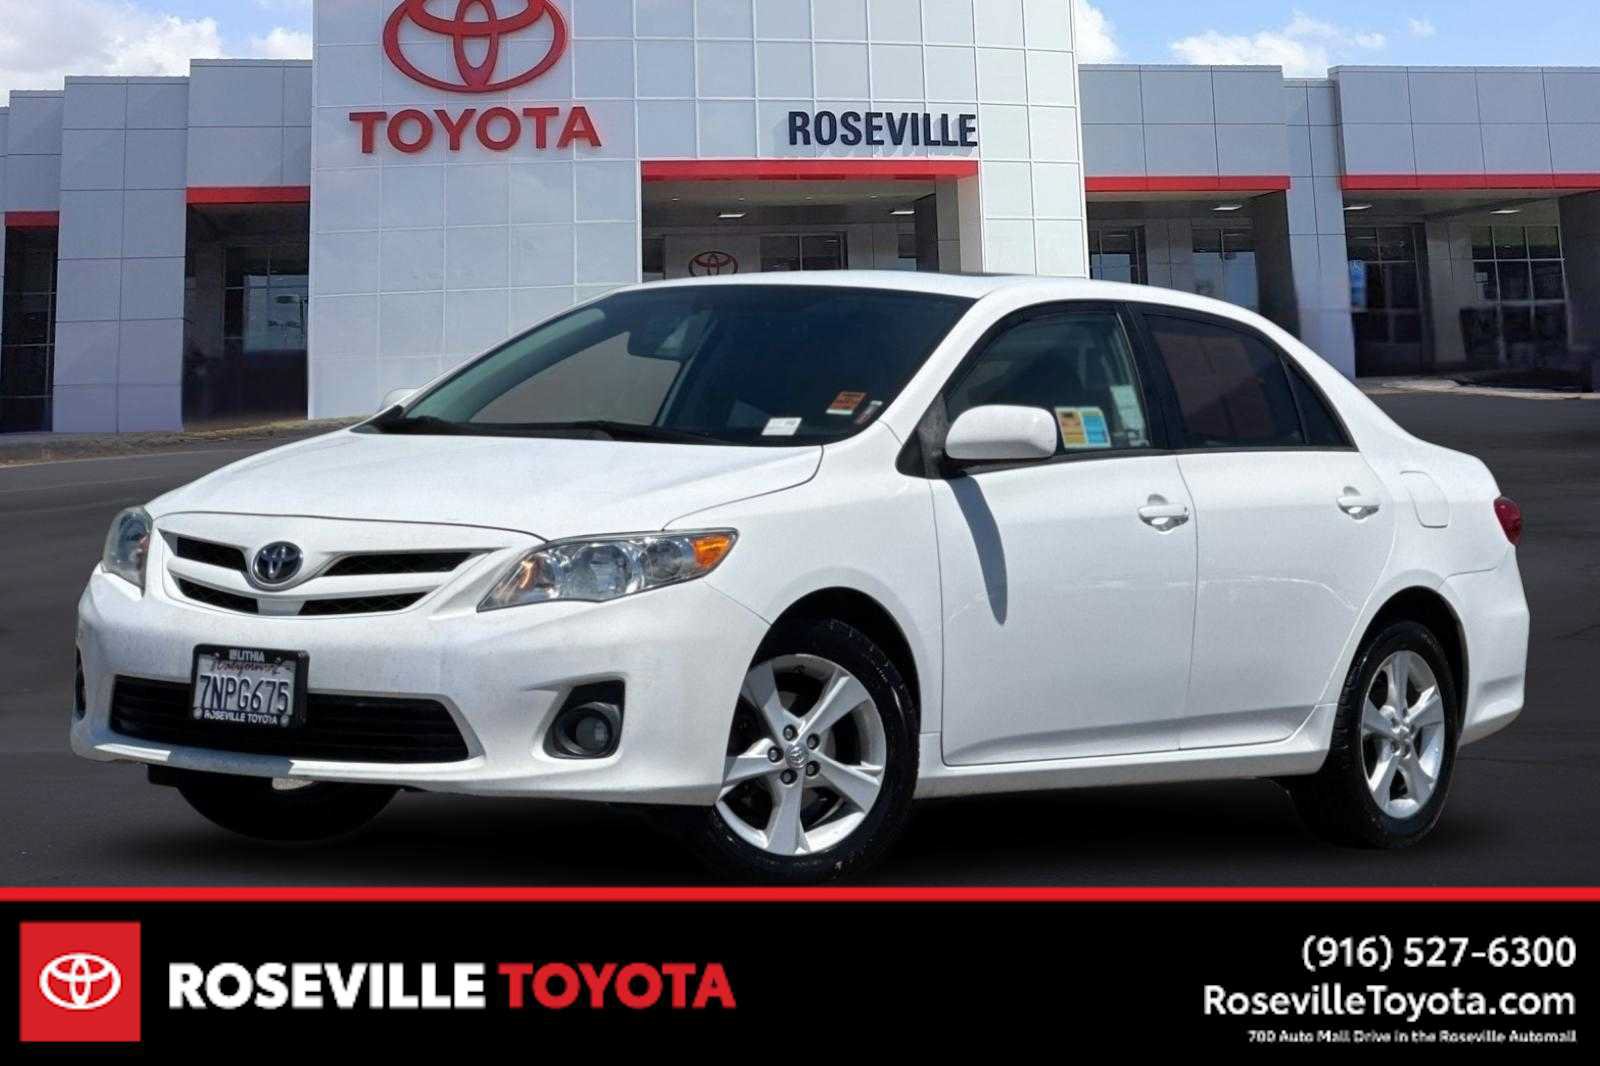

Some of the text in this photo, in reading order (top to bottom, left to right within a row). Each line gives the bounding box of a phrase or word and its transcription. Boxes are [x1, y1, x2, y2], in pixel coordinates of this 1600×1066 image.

[350, 106, 602, 153] TOYOTA
[788, 111, 978, 147] ROSEVILLE
[200, 674, 289, 715] 7NPG675
[204, 709, 278, 725] ROSEVILLE TOYOTA
